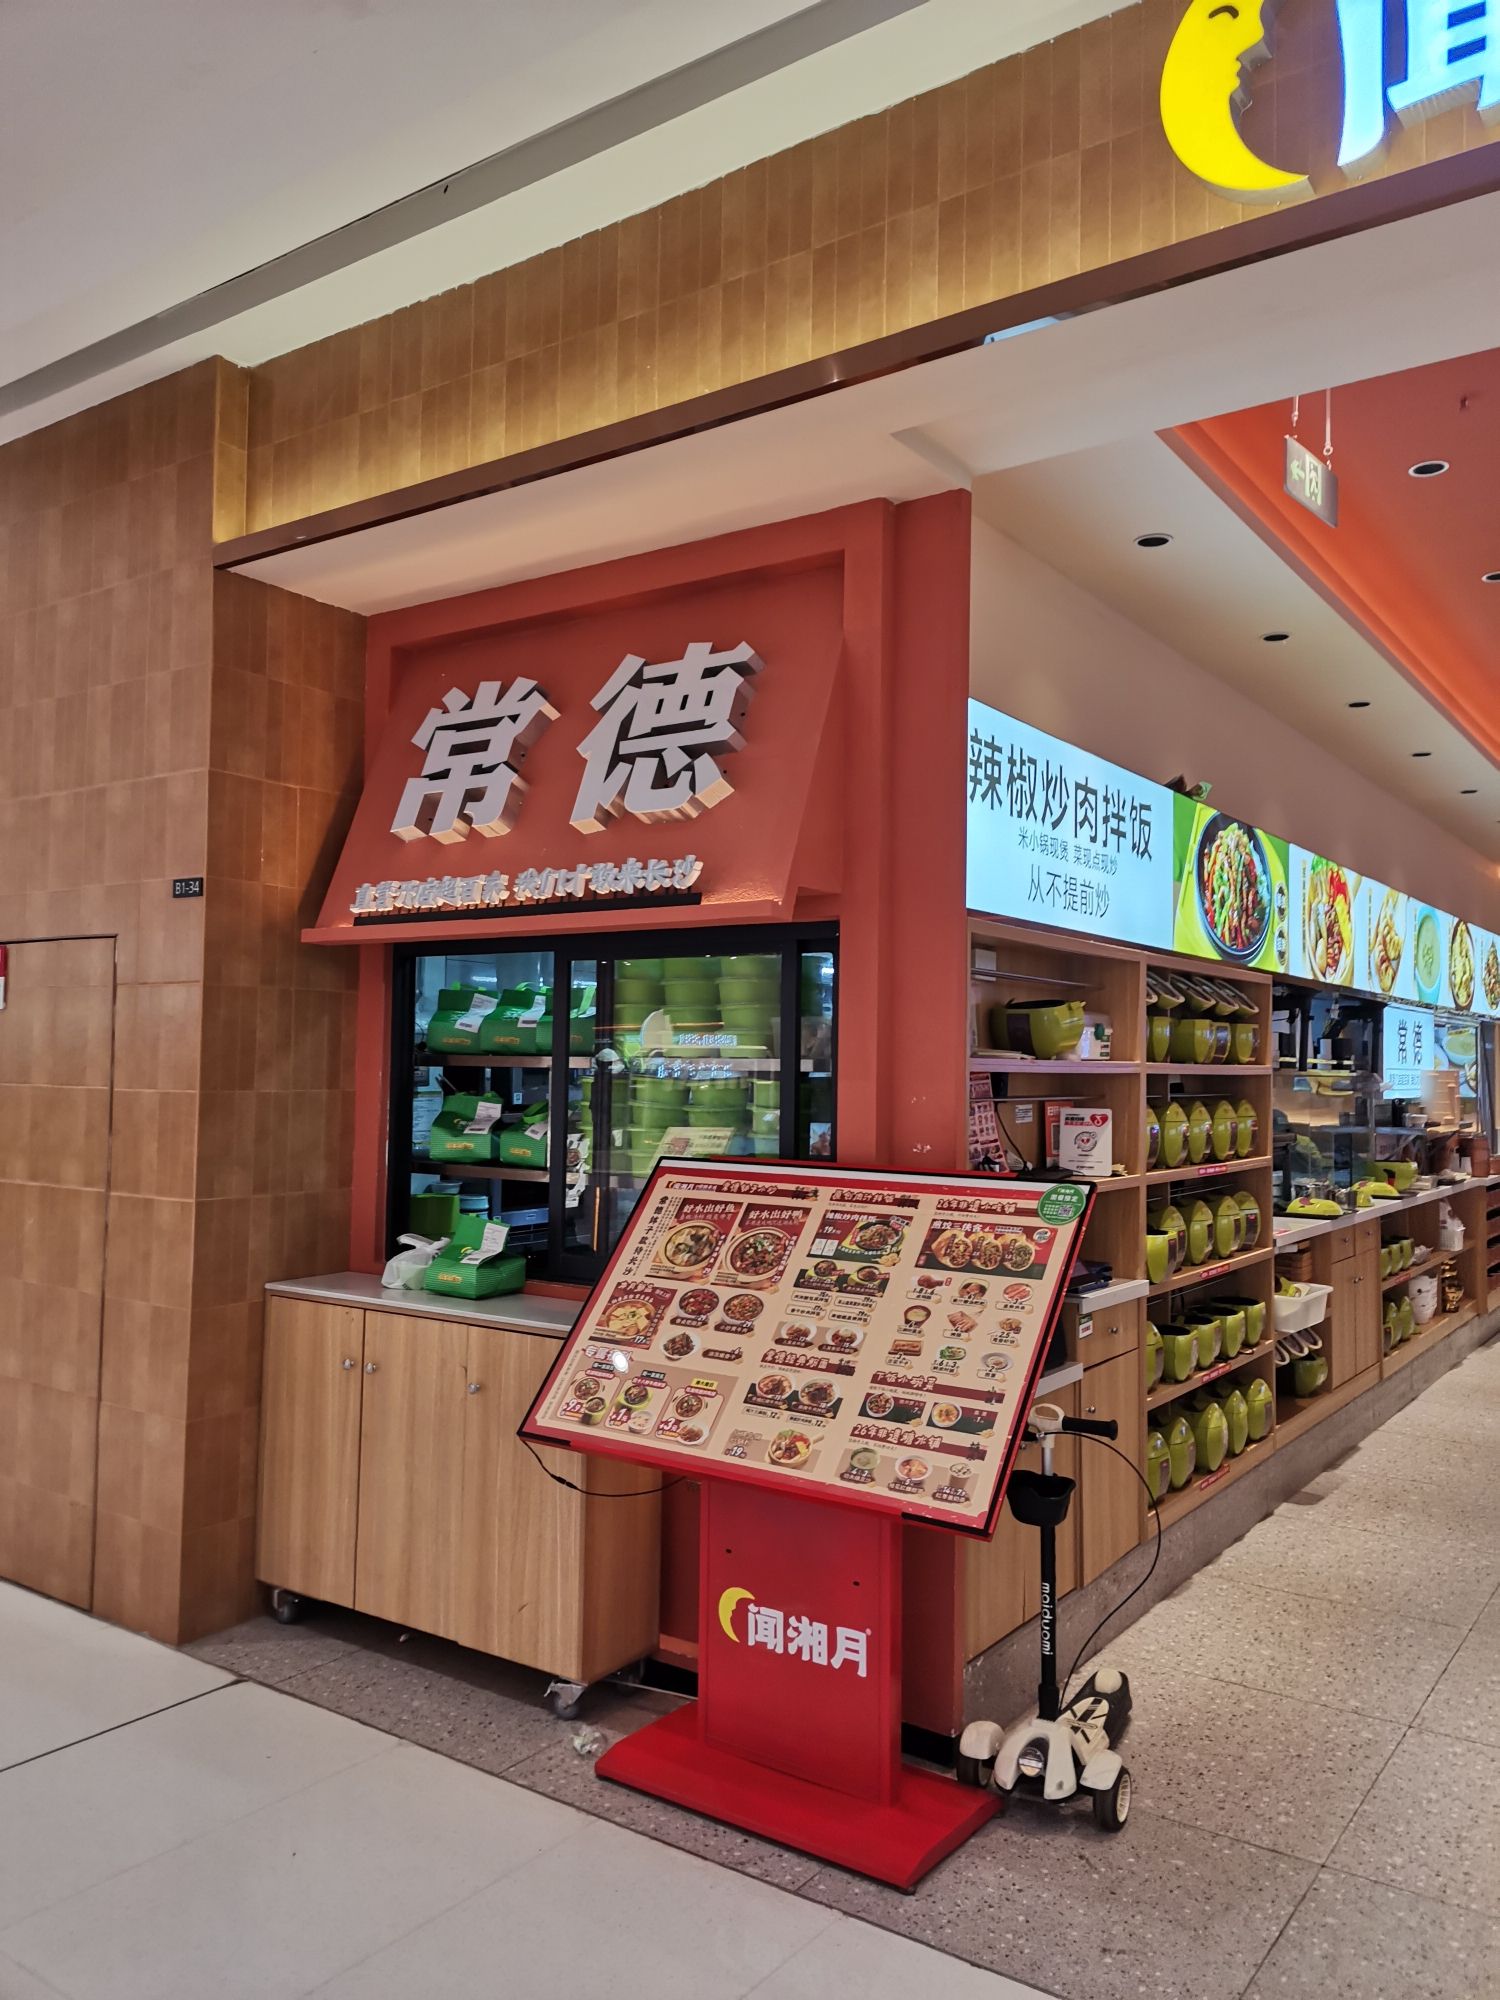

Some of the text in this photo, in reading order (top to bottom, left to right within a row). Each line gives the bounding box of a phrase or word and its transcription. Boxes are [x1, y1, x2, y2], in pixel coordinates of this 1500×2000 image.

[390, 641, 764, 845] 常德
[969, 727, 1153, 862] 辣椒炒肉拌饭
[1018, 826, 1069, 862] 米小锅现煲
[175, 881, 200, 895] B1-34
[513, 854, 703, 900] 我们才敢来长沙
[1027, 863, 1110, 919] 从不提前炒
[682, 1202, 737, 1213] 好水出好鱼
[748, 1209, 804, 1220] 好水出好鸭
[747, 1603, 868, 1678] 闻湘月
